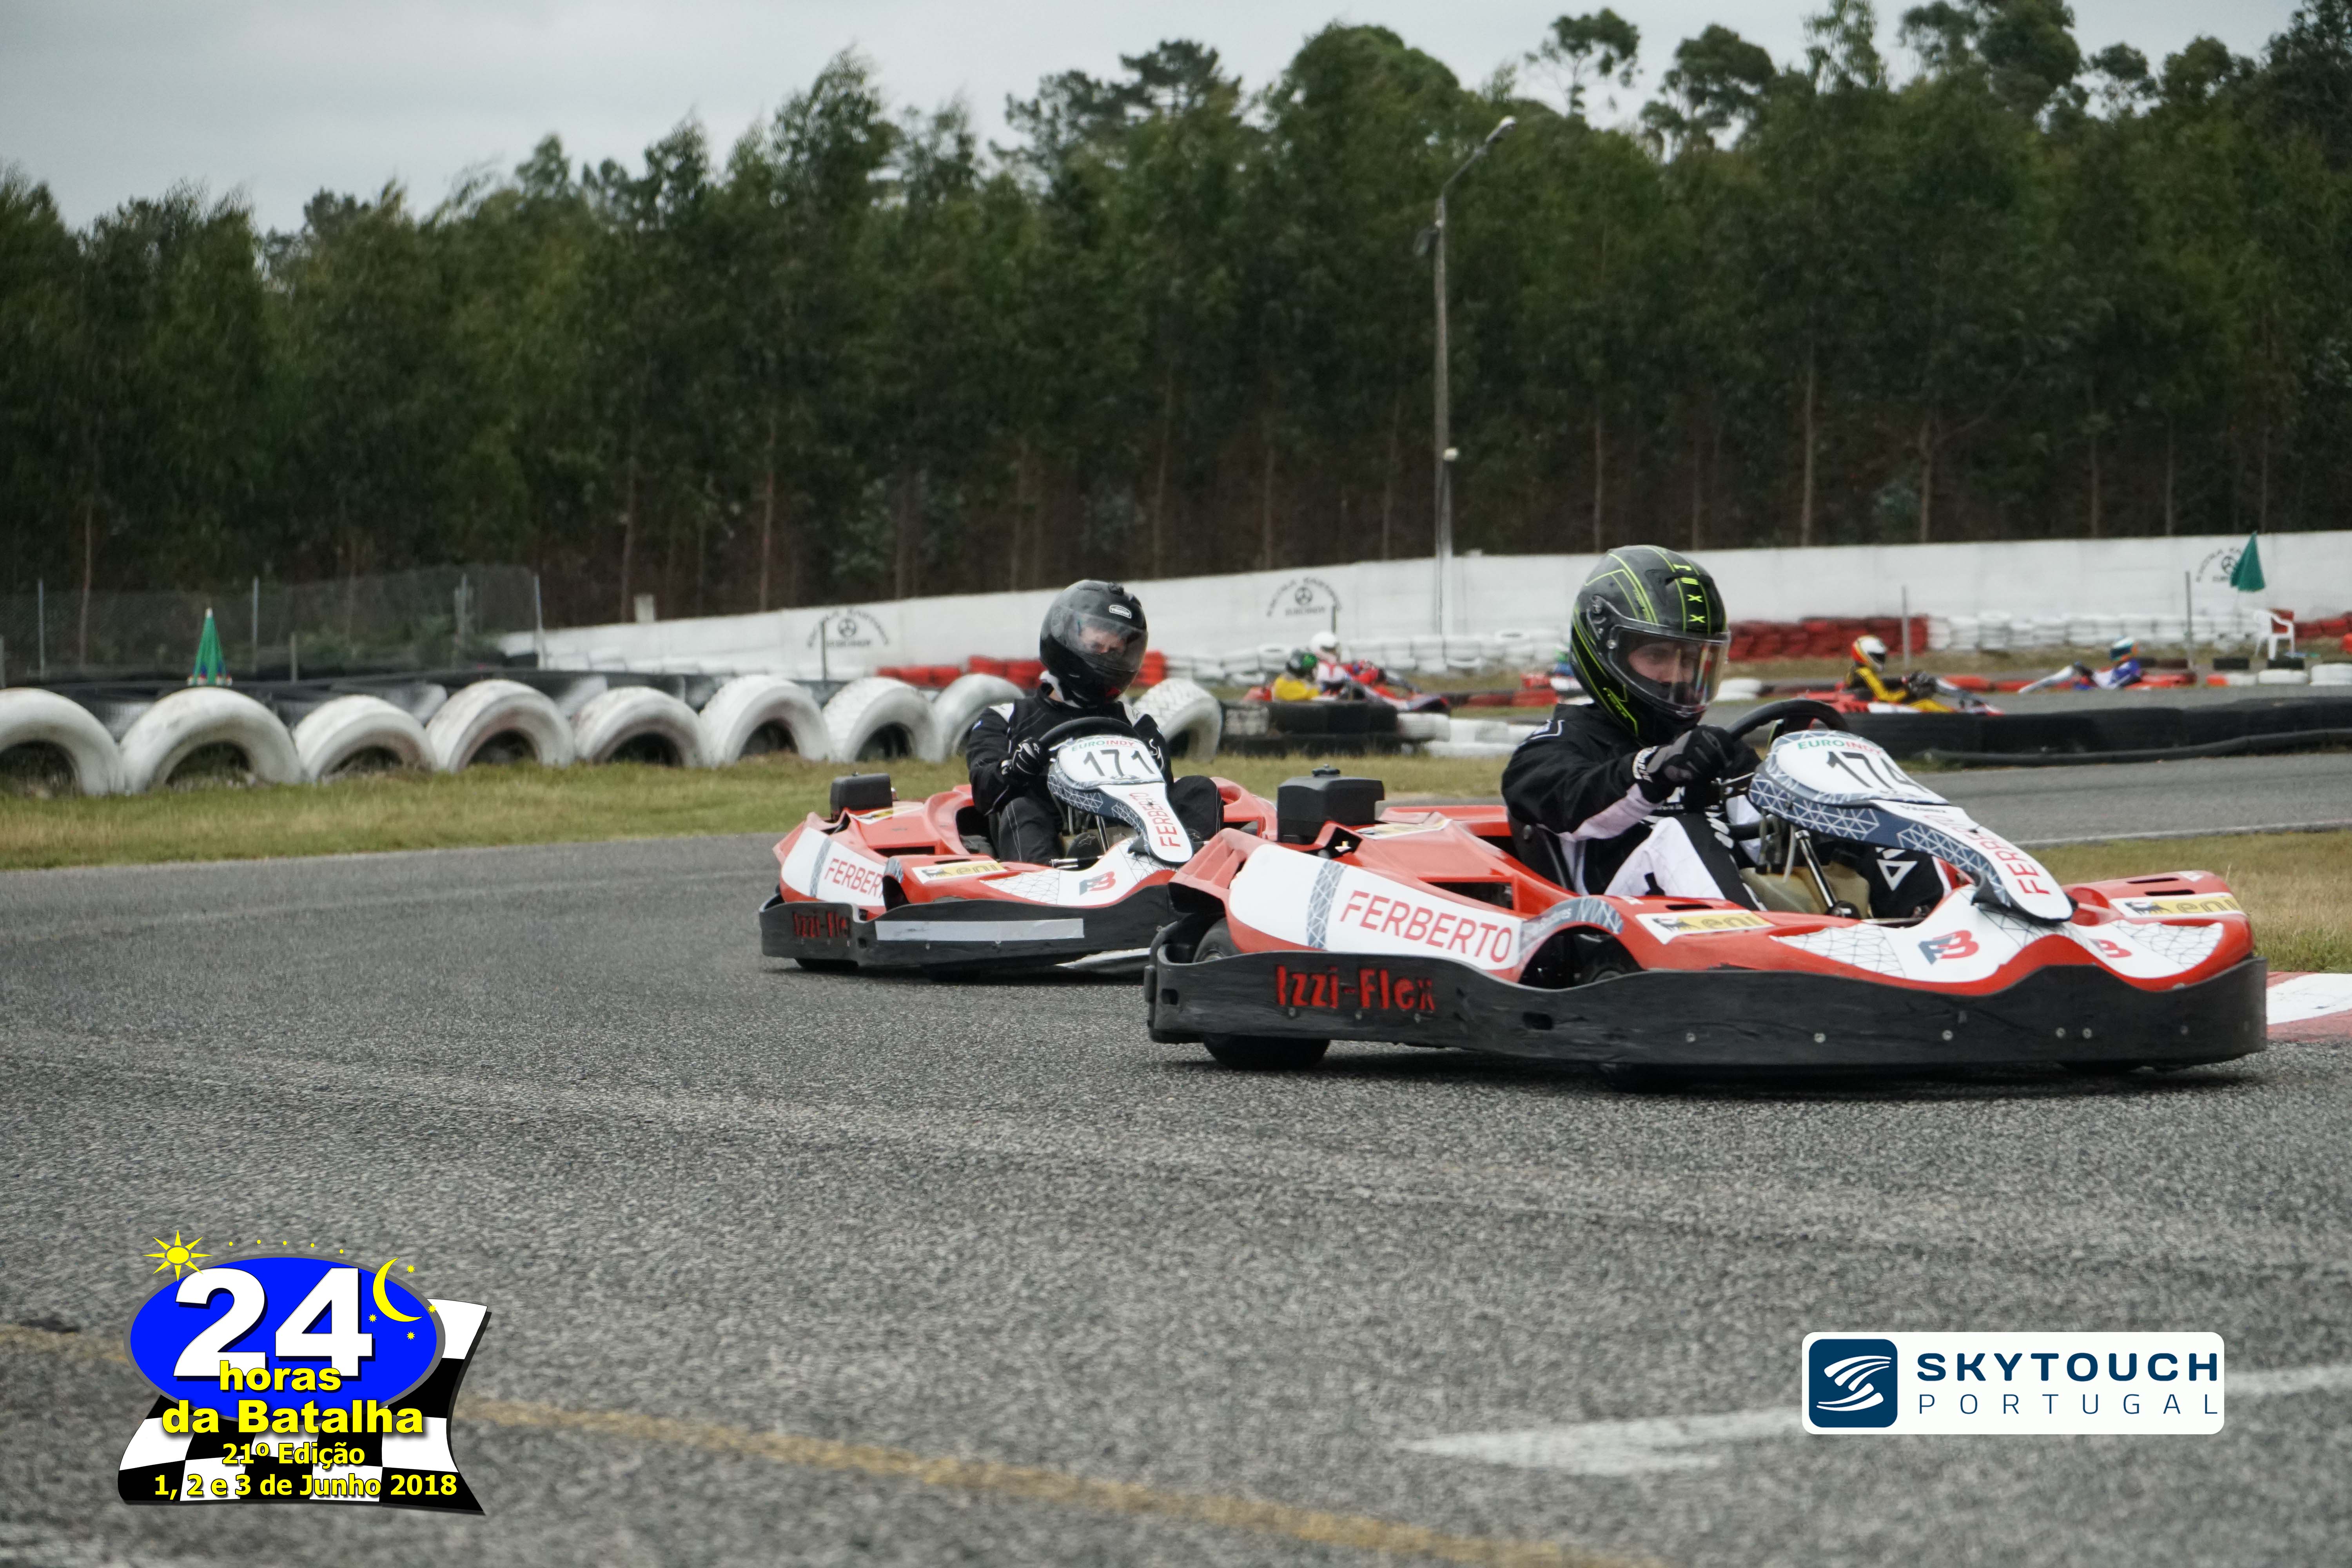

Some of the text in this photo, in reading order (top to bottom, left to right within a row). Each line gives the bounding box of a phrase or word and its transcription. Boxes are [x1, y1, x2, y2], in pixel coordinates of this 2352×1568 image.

[1071, 740, 1135, 751] EUROINDY
[1797, 740, 1880, 755] EUROINDY
[1083, 749, 1155, 778] 171
[1826, 751, 1930, 794] 174
[1129, 792, 1181, 848] FERBERTO
[1923, 815, 2051, 895] FERBERTO
[956, 864, 998, 875] eni
[2176, 899, 2240, 913] eni
[1340, 890, 1512, 963] FERBERTO
[1701, 916, 1764, 929] eni
